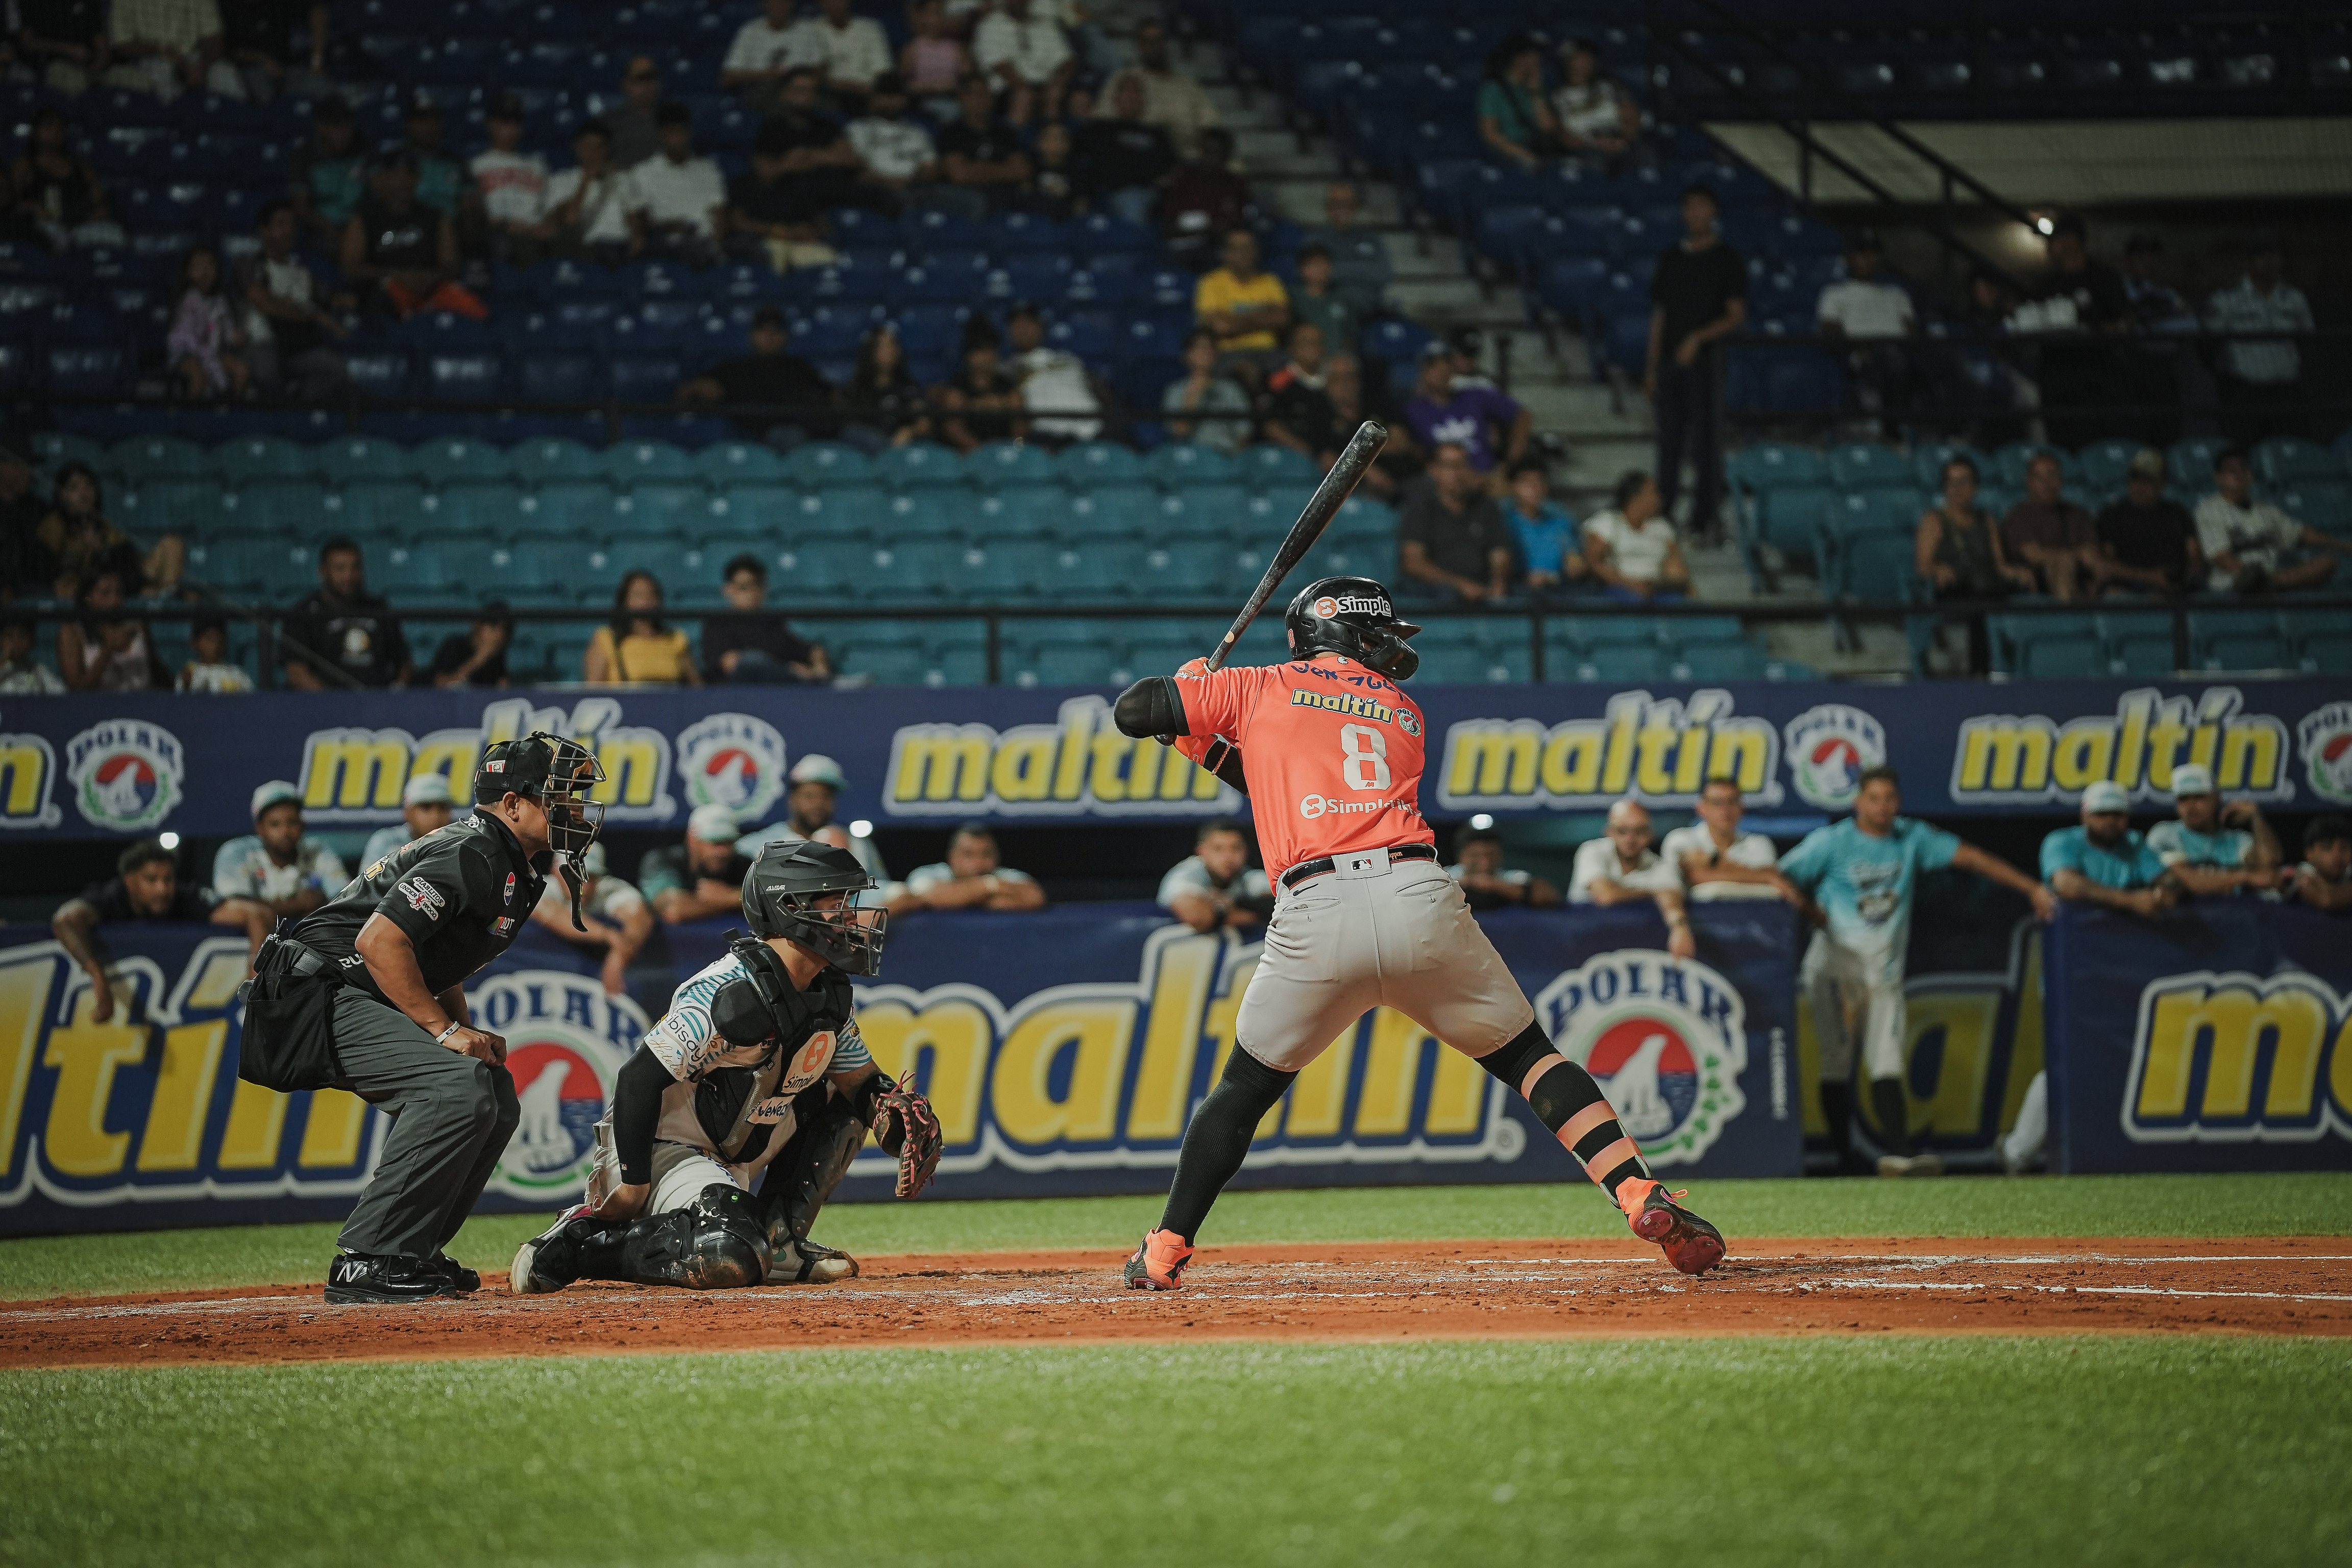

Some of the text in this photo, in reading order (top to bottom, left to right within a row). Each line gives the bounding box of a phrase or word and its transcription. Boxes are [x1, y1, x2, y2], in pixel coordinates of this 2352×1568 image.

[1338, 597, 1391, 615] Simple
[1288, 628, 1295, 649] 8
[1290, 689, 1393, 724] maltín
[75, 724, 177, 771] POLAR
[305, 703, 664, 812] maín
[1340, 723, 1392, 791] 8
[1447, 695, 1771, 796] maltín
[1958, 695, 2282, 792] maltín
[400, 883, 418, 898] UNDER
[422, 901, 438, 919] WOOD
[415, 877, 444, 906] DIABLITOS
[1548, 962, 1732, 1046] POLAR
[666, 1014, 706, 1062] ibisay
[850, 925, 1486, 1146] maln
